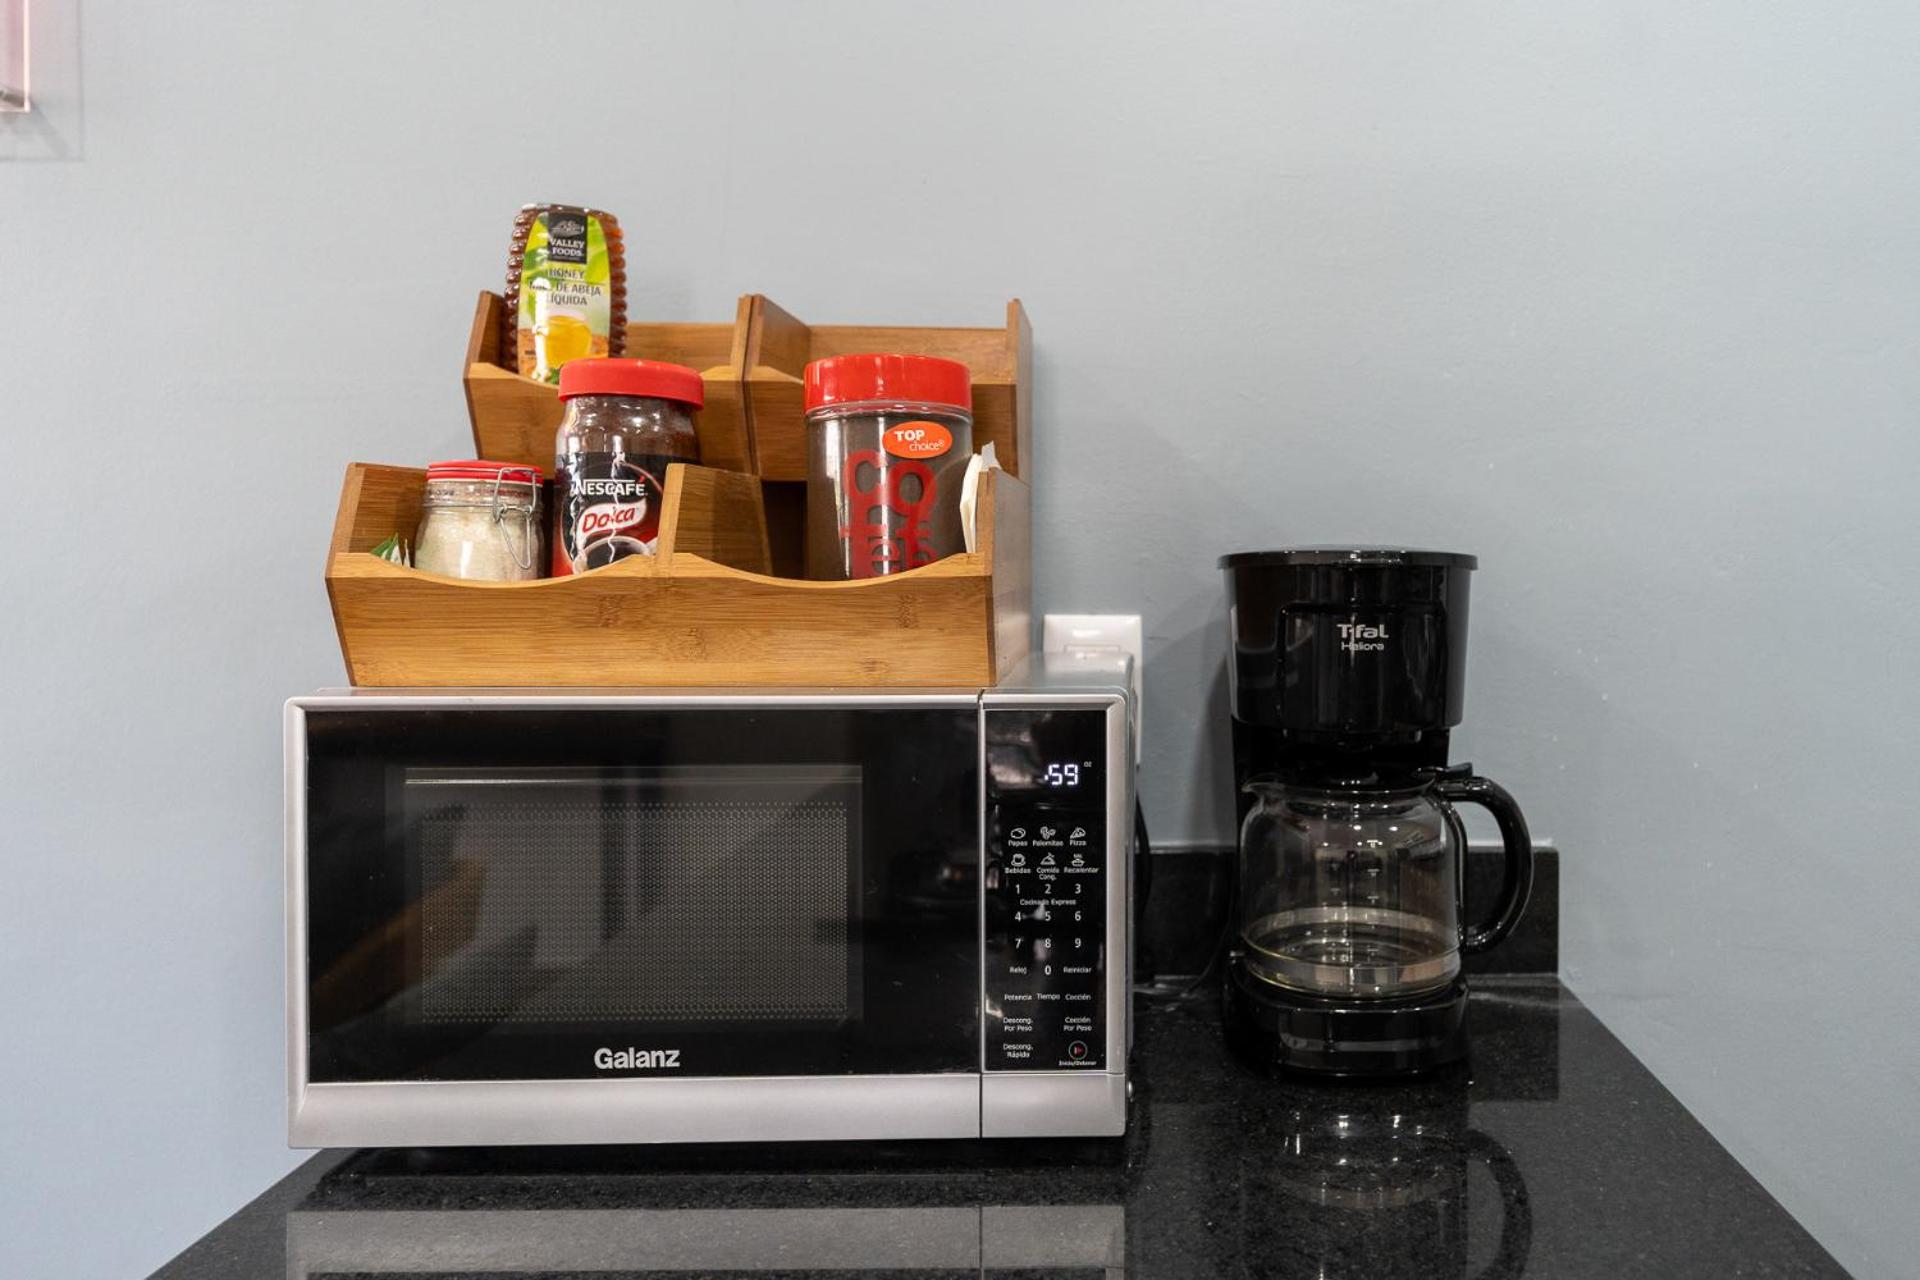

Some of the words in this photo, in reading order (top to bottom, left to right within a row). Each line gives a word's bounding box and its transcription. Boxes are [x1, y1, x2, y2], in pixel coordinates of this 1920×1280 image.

[550, 238, 585, 249] VALLEY
[552, 247, 582, 257] FOODS
[548, 267, 585, 280] HONEY
[557, 282, 569, 292] DE
[571, 284, 601, 297] ABEJA
[550, 292, 588, 305] ÍQUIDA
[894, 429, 925, 442] TOP
[1008, 840, 1028, 848] Papas
[1032, 839, 1064, 847] Palomitas
[1069, 839, 1087, 847] Pizza
[1036, 866, 1060, 874] Comida
[1015, 883, 1021, 895] 1
[1044, 883, 1052, 895] 2
[1074, 883, 1082, 895] 3
[1051, 898, 1077, 907] Express
[1014, 911, 1022, 922] 4
[1045, 911, 1051, 922] 5
[1074, 911, 1082, 922] 6
[1015, 938, 1022, 949] 7
[1044, 938, 1051, 949] 8
[1074, 938, 1082, 949] 9
[1009, 966, 1027, 975] Reloj
[1044, 965, 1052, 976] 0
[1063, 966, 1092, 974] Reiniciar
[1004, 993, 1033, 1001] Potencia
[1036, 992, 1061, 1001] Tiempo
[1065, 993, 1092, 1001] Cocción
[1064, 1016, 1091, 1024] Cocción
[1063, 1024, 1075, 1032] Por
[1076, 1024, 1093, 1032] Peso
[593, 1047, 680, 1070] Galanz
[1007, 1051, 1030, 1059] Rápido
